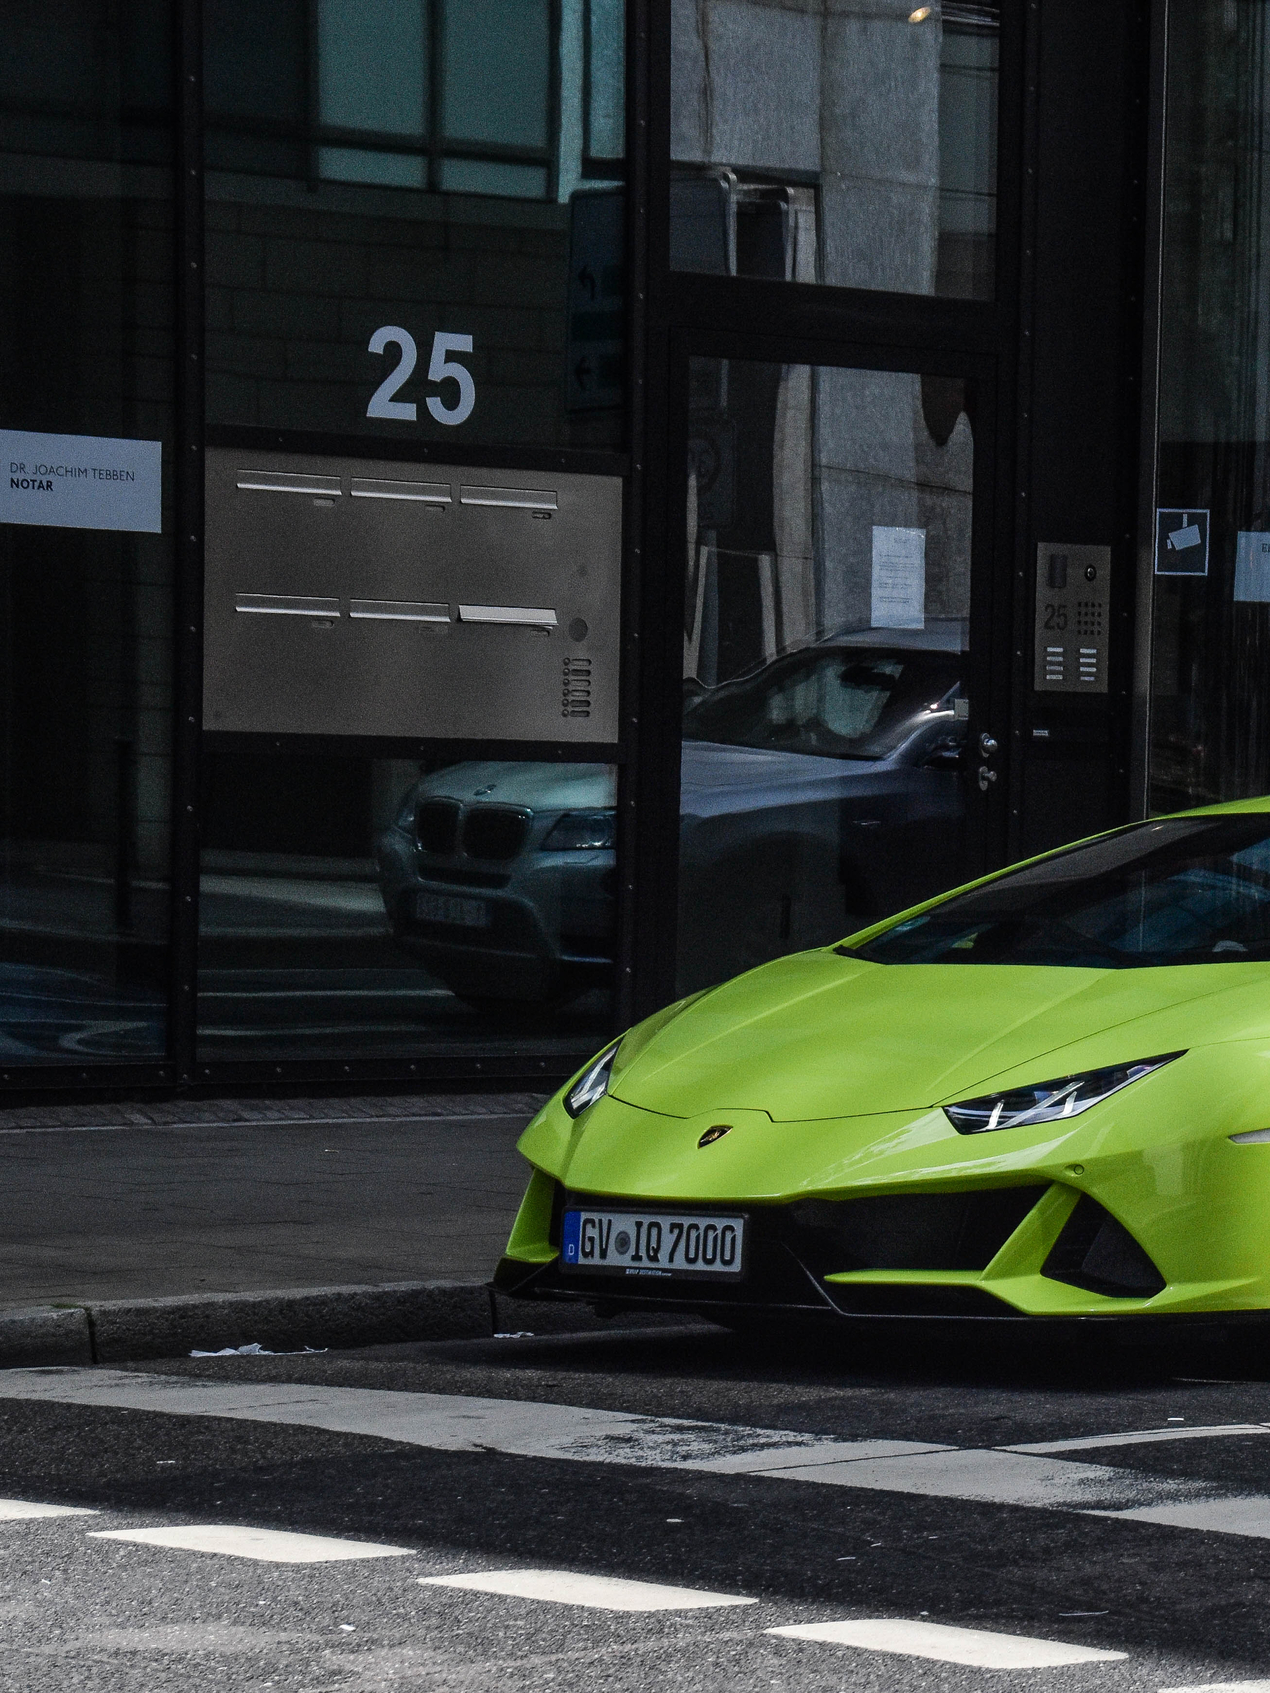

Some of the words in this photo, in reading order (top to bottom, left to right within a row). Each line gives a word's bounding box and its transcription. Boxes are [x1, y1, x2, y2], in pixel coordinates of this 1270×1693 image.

[366, 325, 476, 425] 25
[10, 462, 29, 474] DR.
[33, 464, 88, 479] JOACHIM
[91, 468, 135, 482] TEBBEN
[10, 478, 54, 491] NOTAR
[1043, 603, 1068, 631] 25
[580, 1217, 612, 1261] GV
